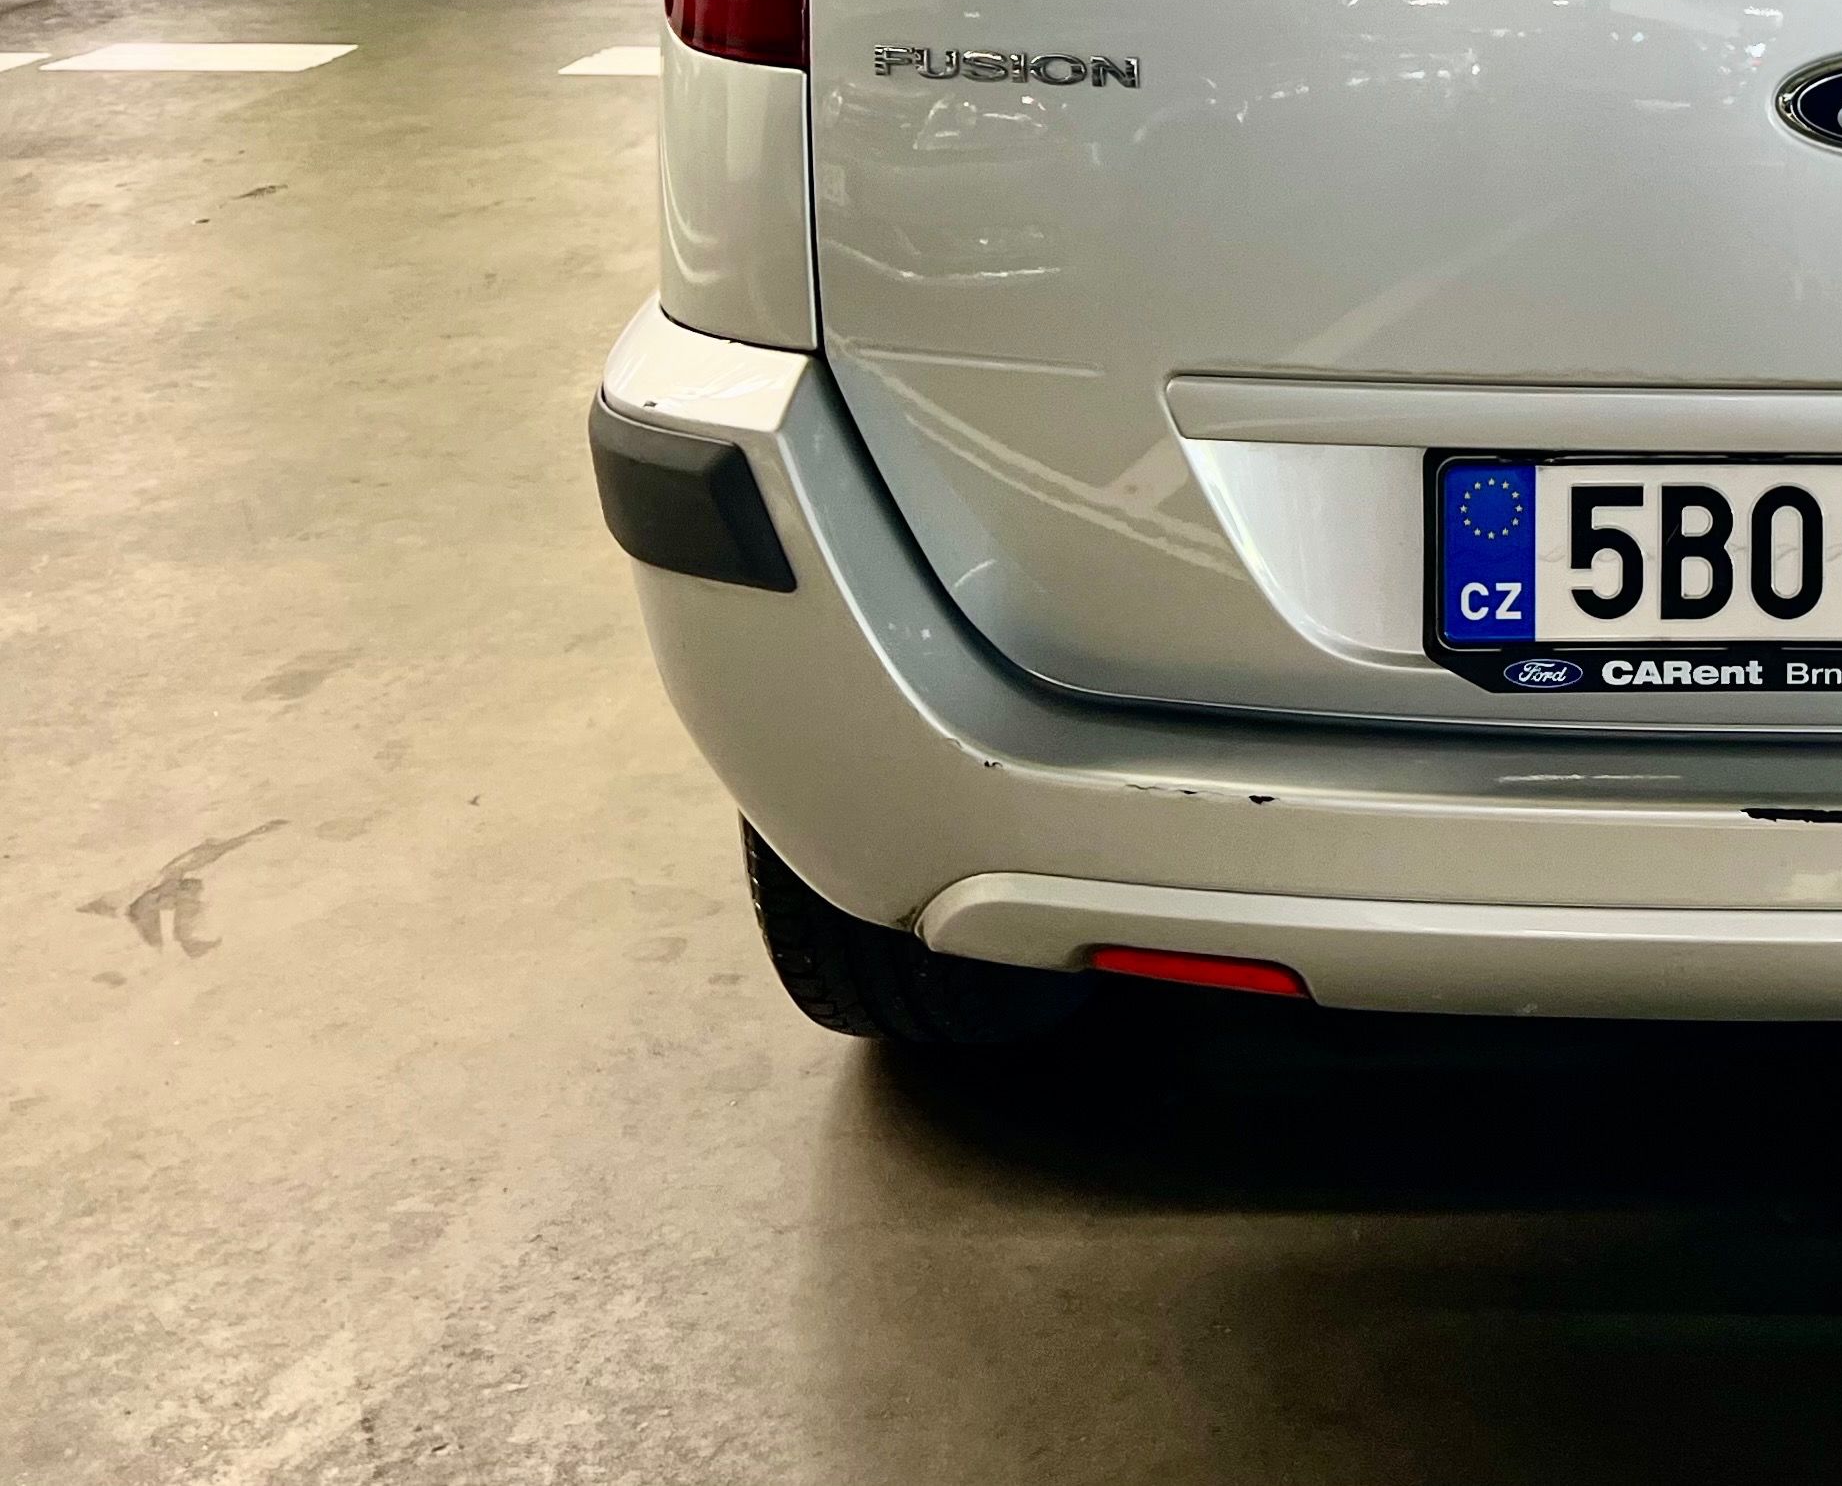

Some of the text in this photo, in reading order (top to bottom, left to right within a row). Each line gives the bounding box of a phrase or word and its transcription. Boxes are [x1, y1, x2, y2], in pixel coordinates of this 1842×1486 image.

[874, 45, 1140, 88] FUSION
[1570, 485, 1823, 620] 5B0
[1460, 582, 1523, 621] CZ
[1518, 662, 1567, 682] Ford
[1601, 660, 1763, 685] CARent
